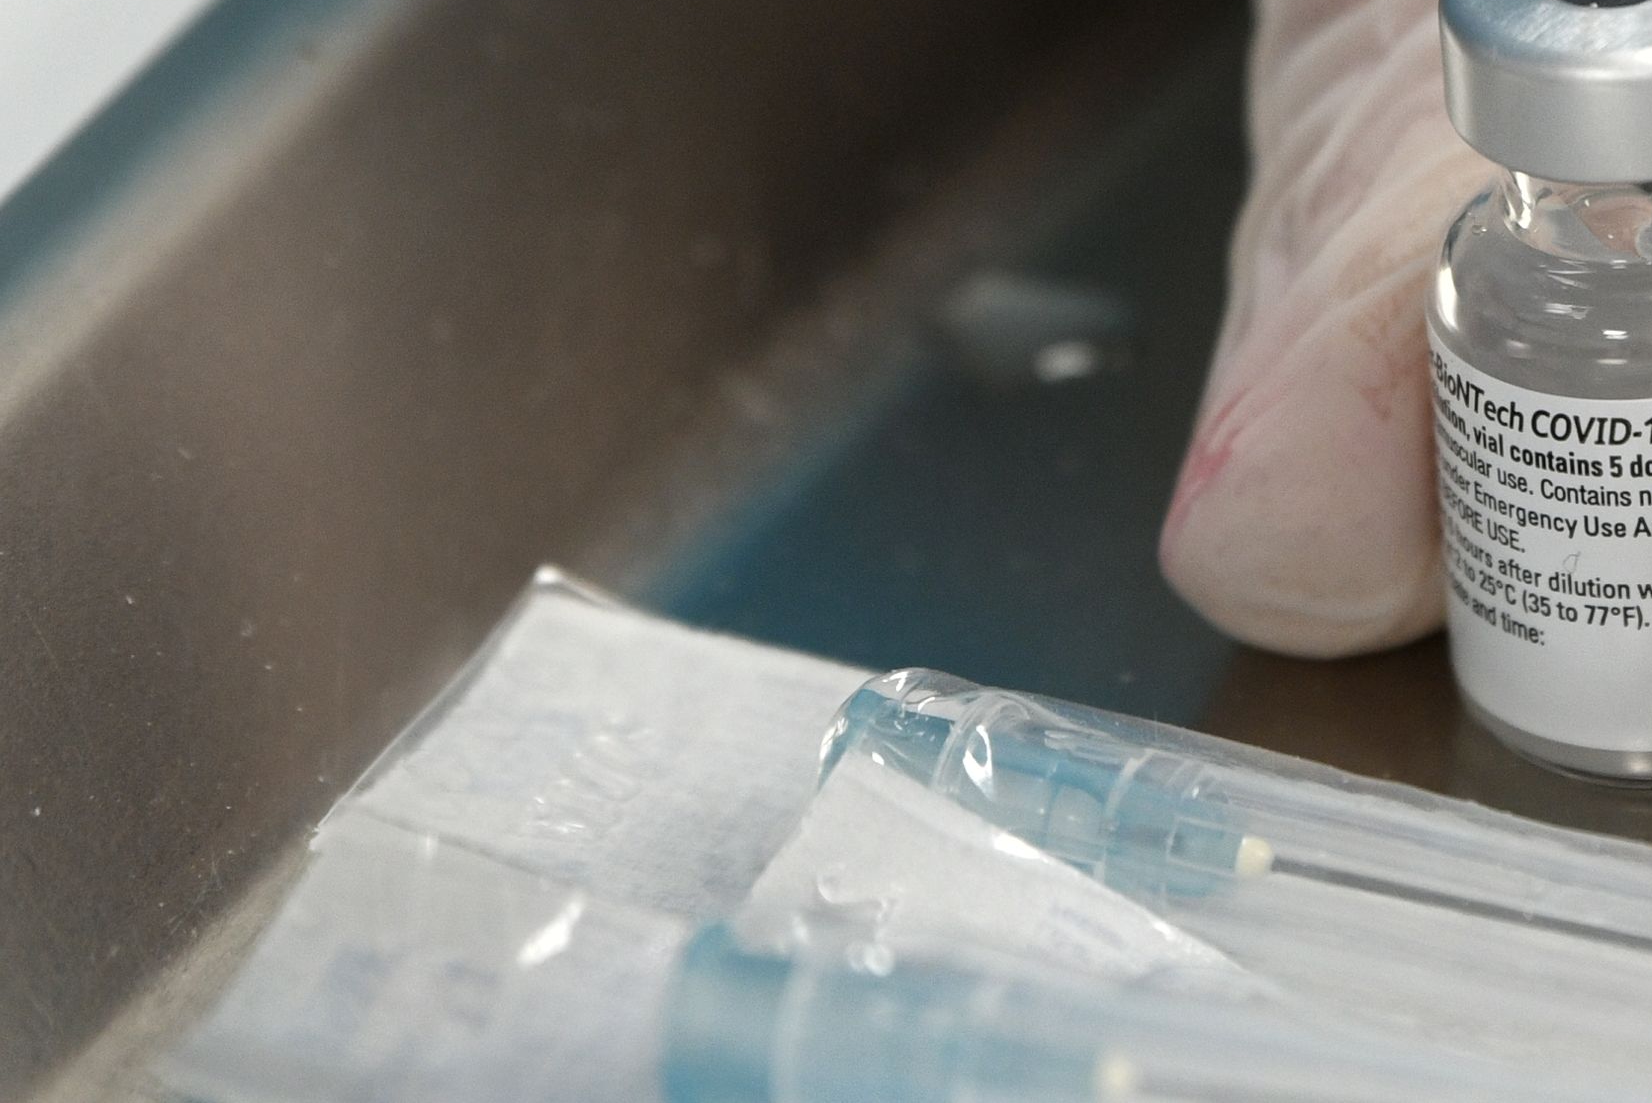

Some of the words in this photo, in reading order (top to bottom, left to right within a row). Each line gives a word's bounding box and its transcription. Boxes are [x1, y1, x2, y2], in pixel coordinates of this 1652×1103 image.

[1473, 426, 1504, 457] vial
[1510, 445, 1604, 478] contains
[1609, 455, 1623, 478] 5
[1474, 481, 1577, 539] Emergency
[1584, 515, 1627, 538] Use
[1497, 468, 1534, 495] use.
[1541, 478, 1632, 507] Contains
[1487, 518, 1525, 553] USE.
[1479, 570, 1517, 605] 25°C
[1522, 590, 1551, 617] (35
[1556, 601, 1578, 622] to
[1584, 604, 1650, 630] 77°F).
[1498, 558, 1542, 587] after
[1548, 572, 1631, 599] dilution
[1471, 598, 1497, 627] and
[1501, 611, 1545, 646] time:
